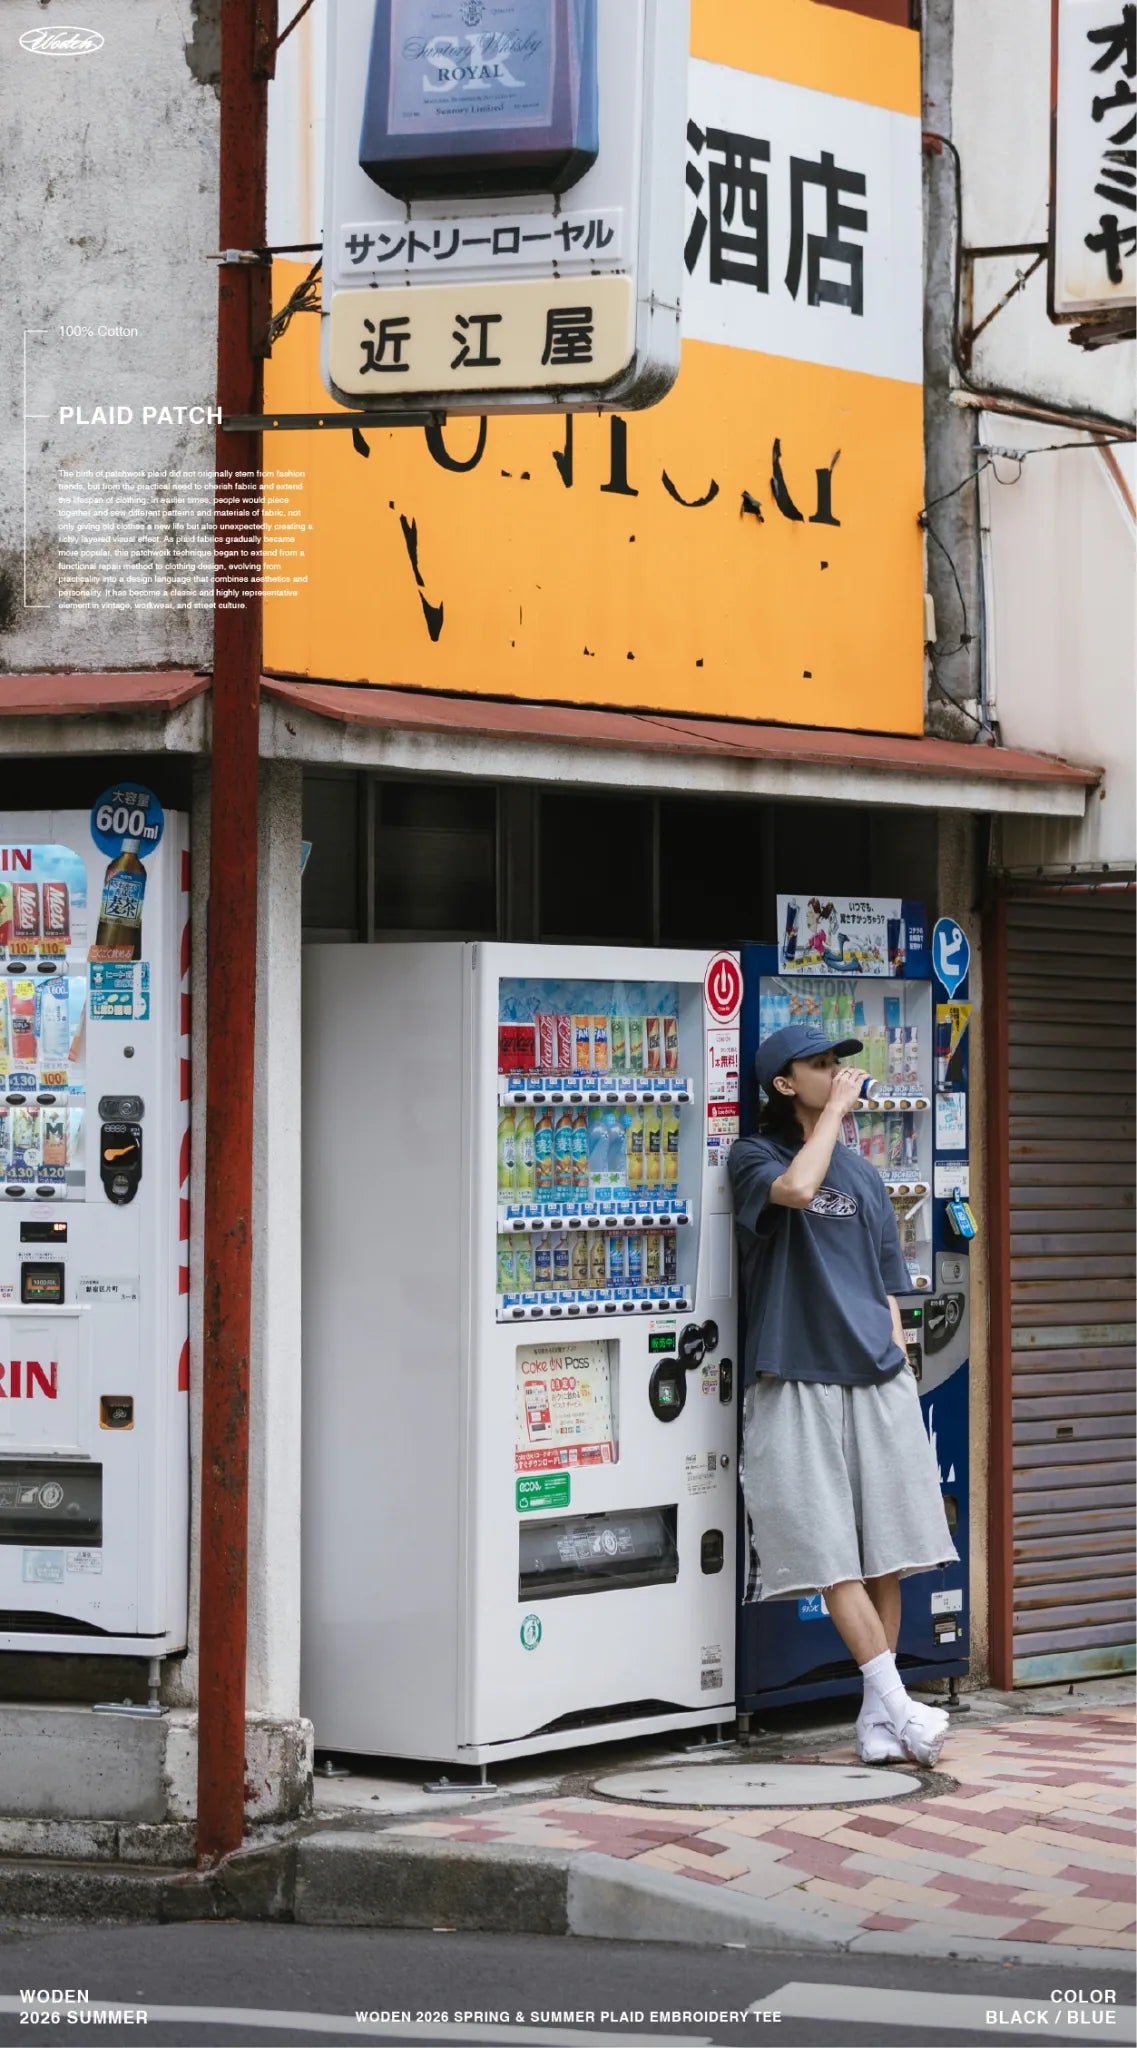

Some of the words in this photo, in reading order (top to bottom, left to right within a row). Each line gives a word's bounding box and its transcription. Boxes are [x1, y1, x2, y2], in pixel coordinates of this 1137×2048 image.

[438, 64, 504, 81] ROYAL
[345, 219, 615, 264] サントリーローヤル
[359, 306, 594, 375] 近江屋
[112, 790, 150, 808] 大容量
[96, 804, 159, 839] 600ml
[20, 887, 36, 930] Mets
[49, 887, 65, 930] Mets
[107, 896, 136, 917] 麦茶
[939, 926, 963, 977] ピ
[521, 1359, 548, 1375] Coke
[550, 1356, 563, 1372] ON
[565, 1356, 590, 1370] Pass
